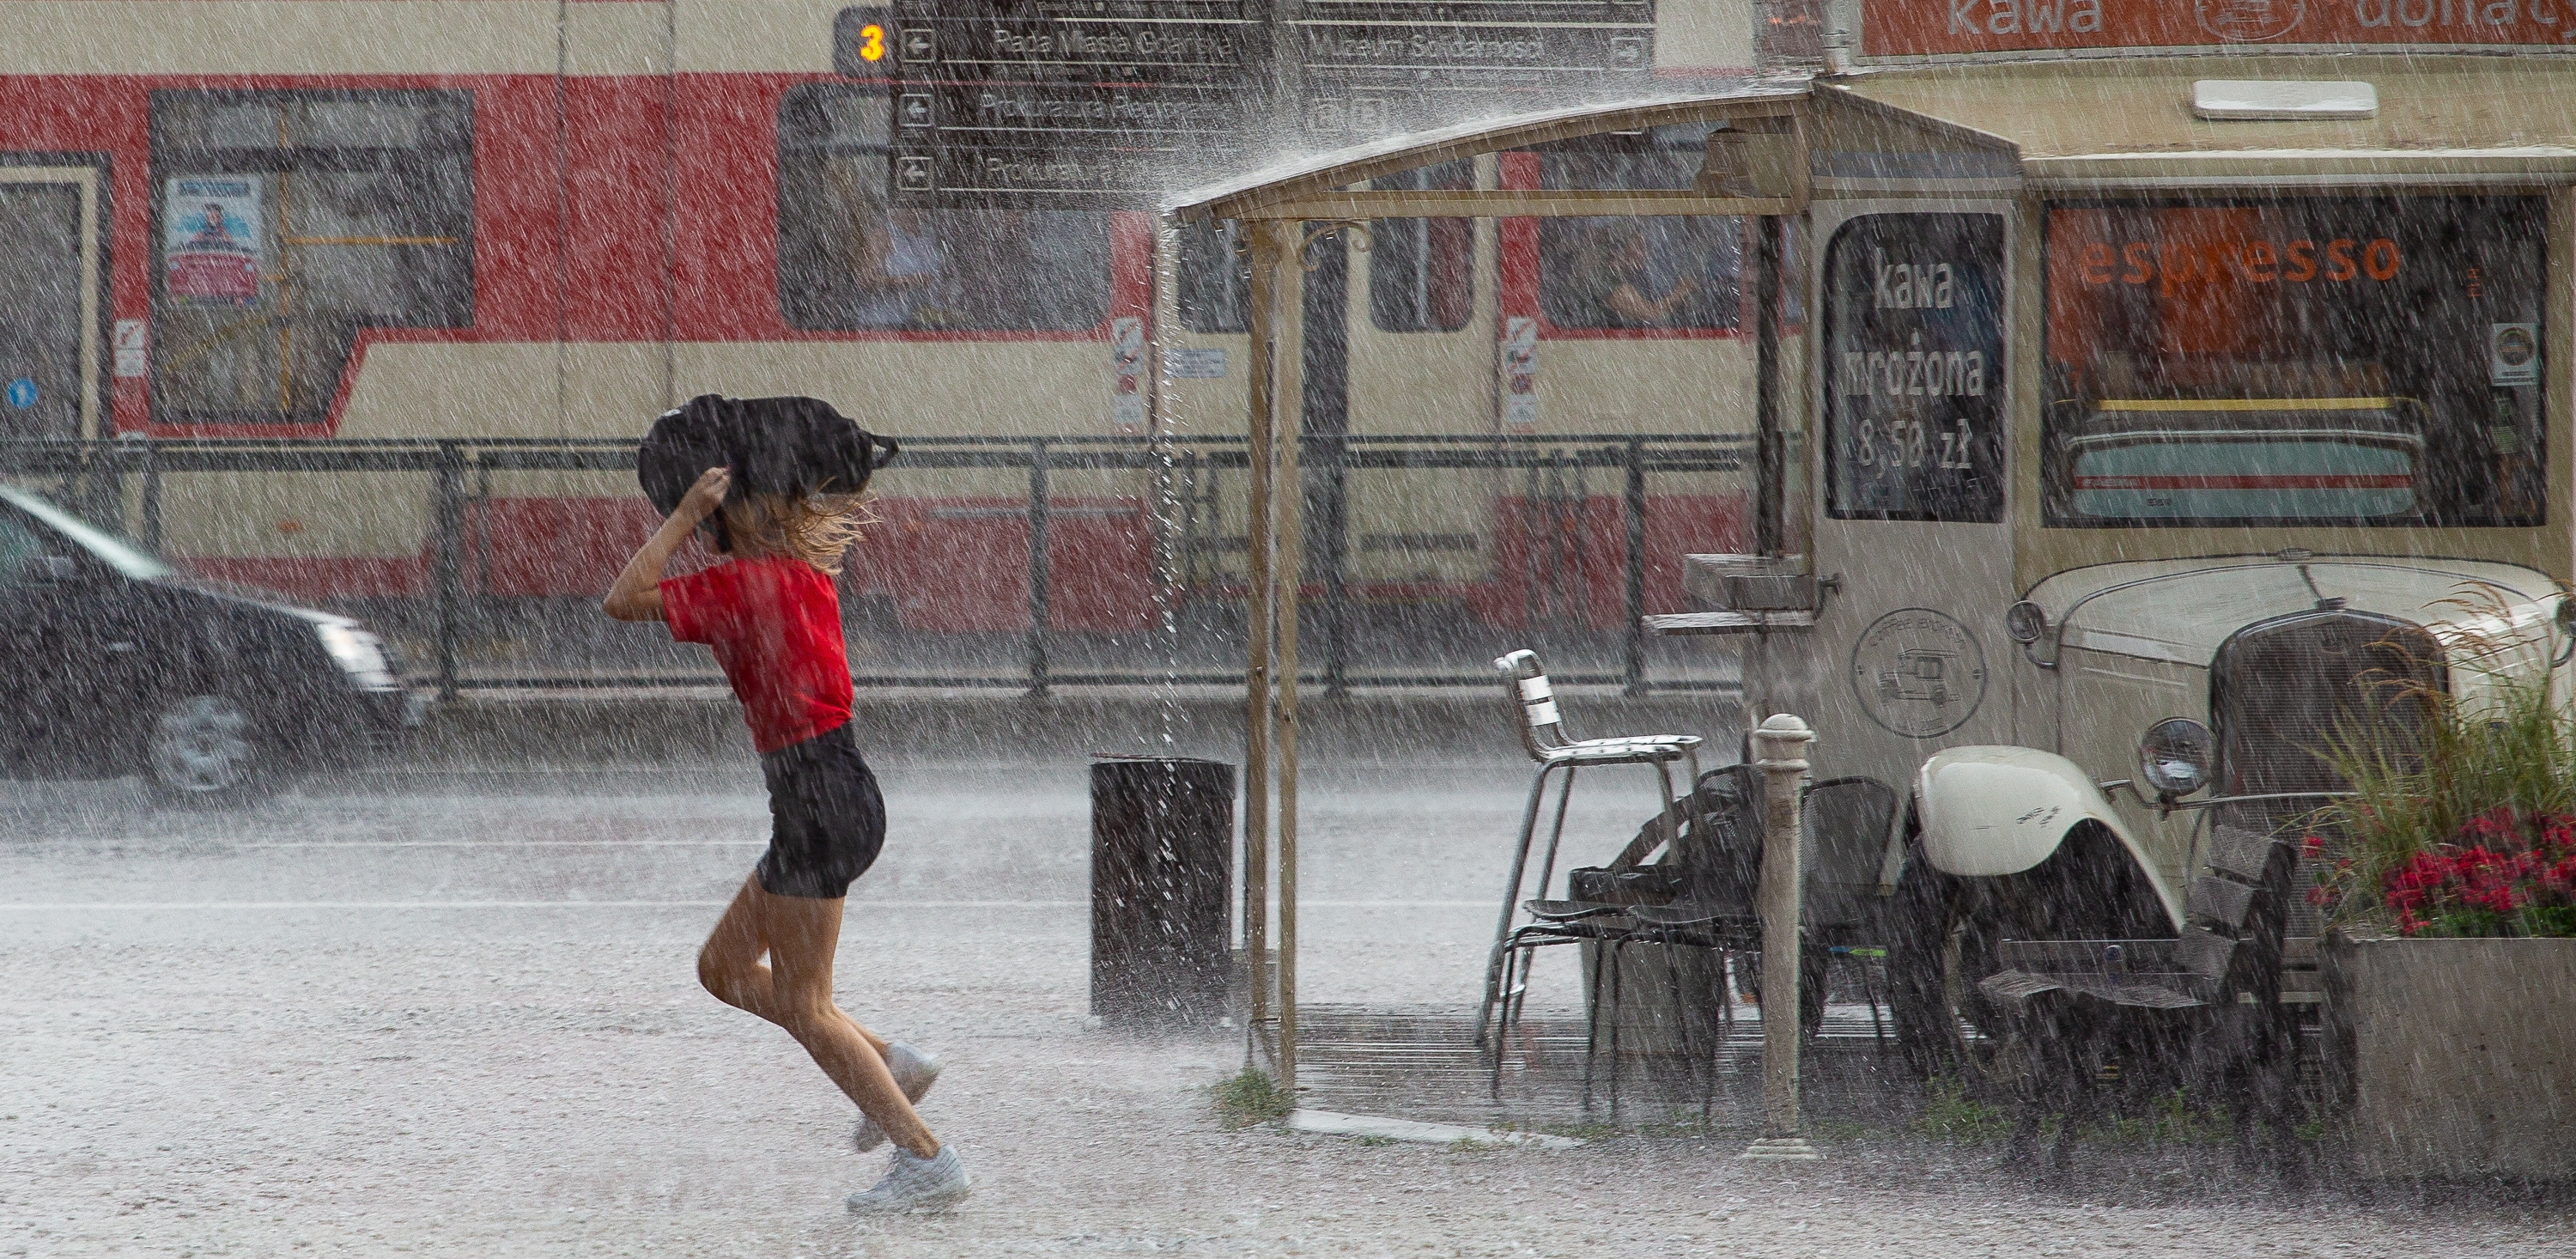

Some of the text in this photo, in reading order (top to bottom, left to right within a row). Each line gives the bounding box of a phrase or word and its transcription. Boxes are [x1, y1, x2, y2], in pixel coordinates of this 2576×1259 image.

[860, 23, 885, 62] 3
[1947, 0, 2103, 34] kawa
[1873, 246, 1954, 310] kawa
[2079, 237, 2401, 298] espresso
[1844, 327, 1985, 397] mrożona
[1857, 418, 1972, 479] 8,50 zł
